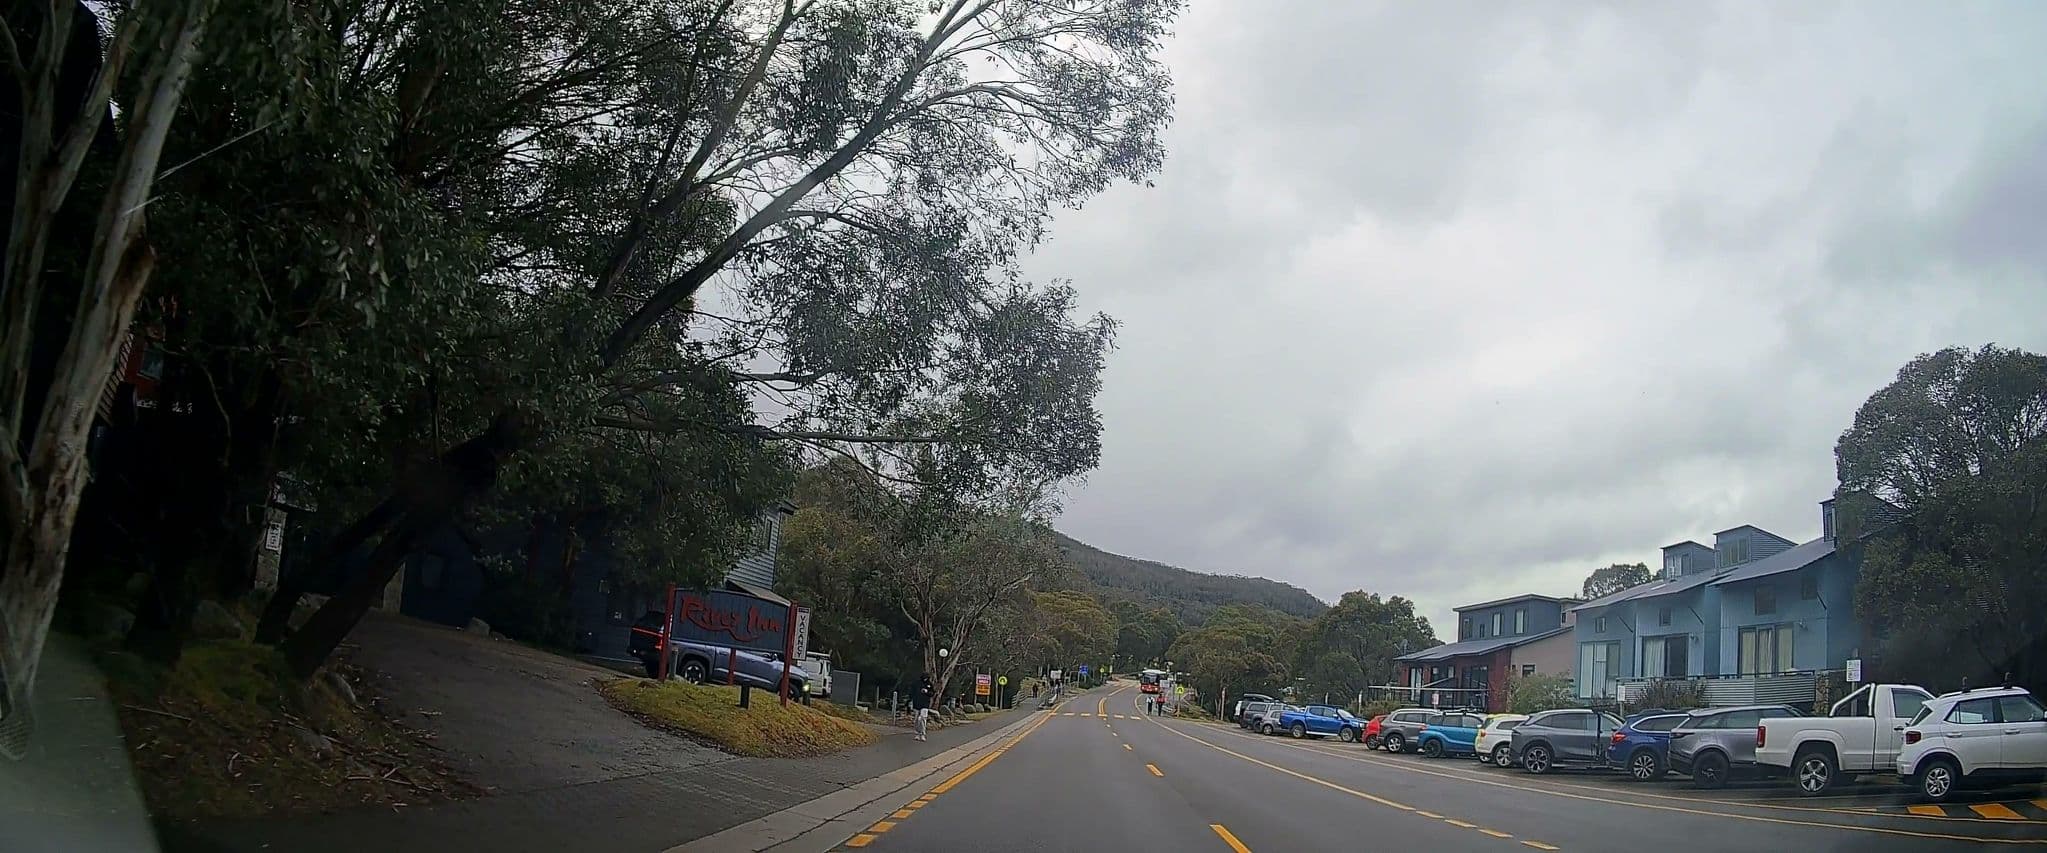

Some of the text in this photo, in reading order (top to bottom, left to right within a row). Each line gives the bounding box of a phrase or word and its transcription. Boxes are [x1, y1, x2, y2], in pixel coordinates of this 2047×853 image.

[680, 596, 782, 634] River Inn
[797, 615, 806, 658] VACANCY
